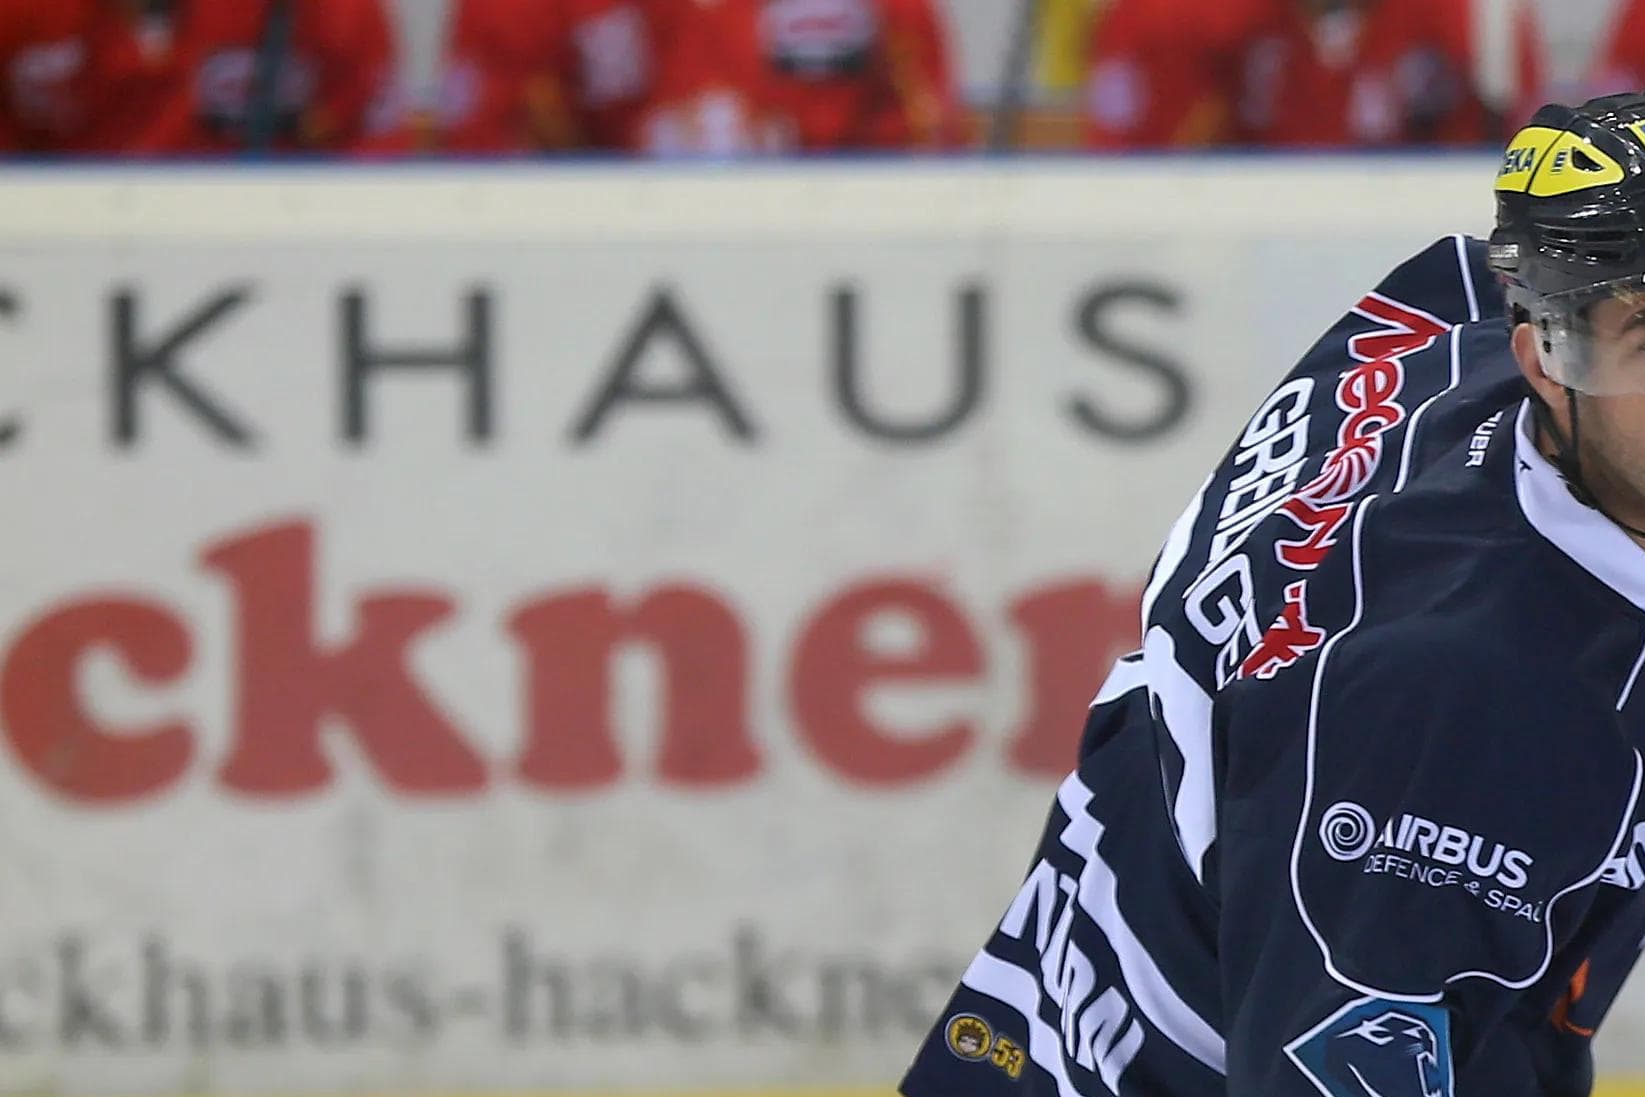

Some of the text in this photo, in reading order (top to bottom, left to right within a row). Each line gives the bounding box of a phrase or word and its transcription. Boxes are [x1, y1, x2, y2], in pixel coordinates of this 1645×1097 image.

[1501, 147, 1536, 175] EKA
[0, 276, 1195, 449] KHAUS
[1363, 854, 1462, 887] DEFENCE
[1463, 880, 1481, 896] &
[1373, 813, 1534, 889] AIRBUS
